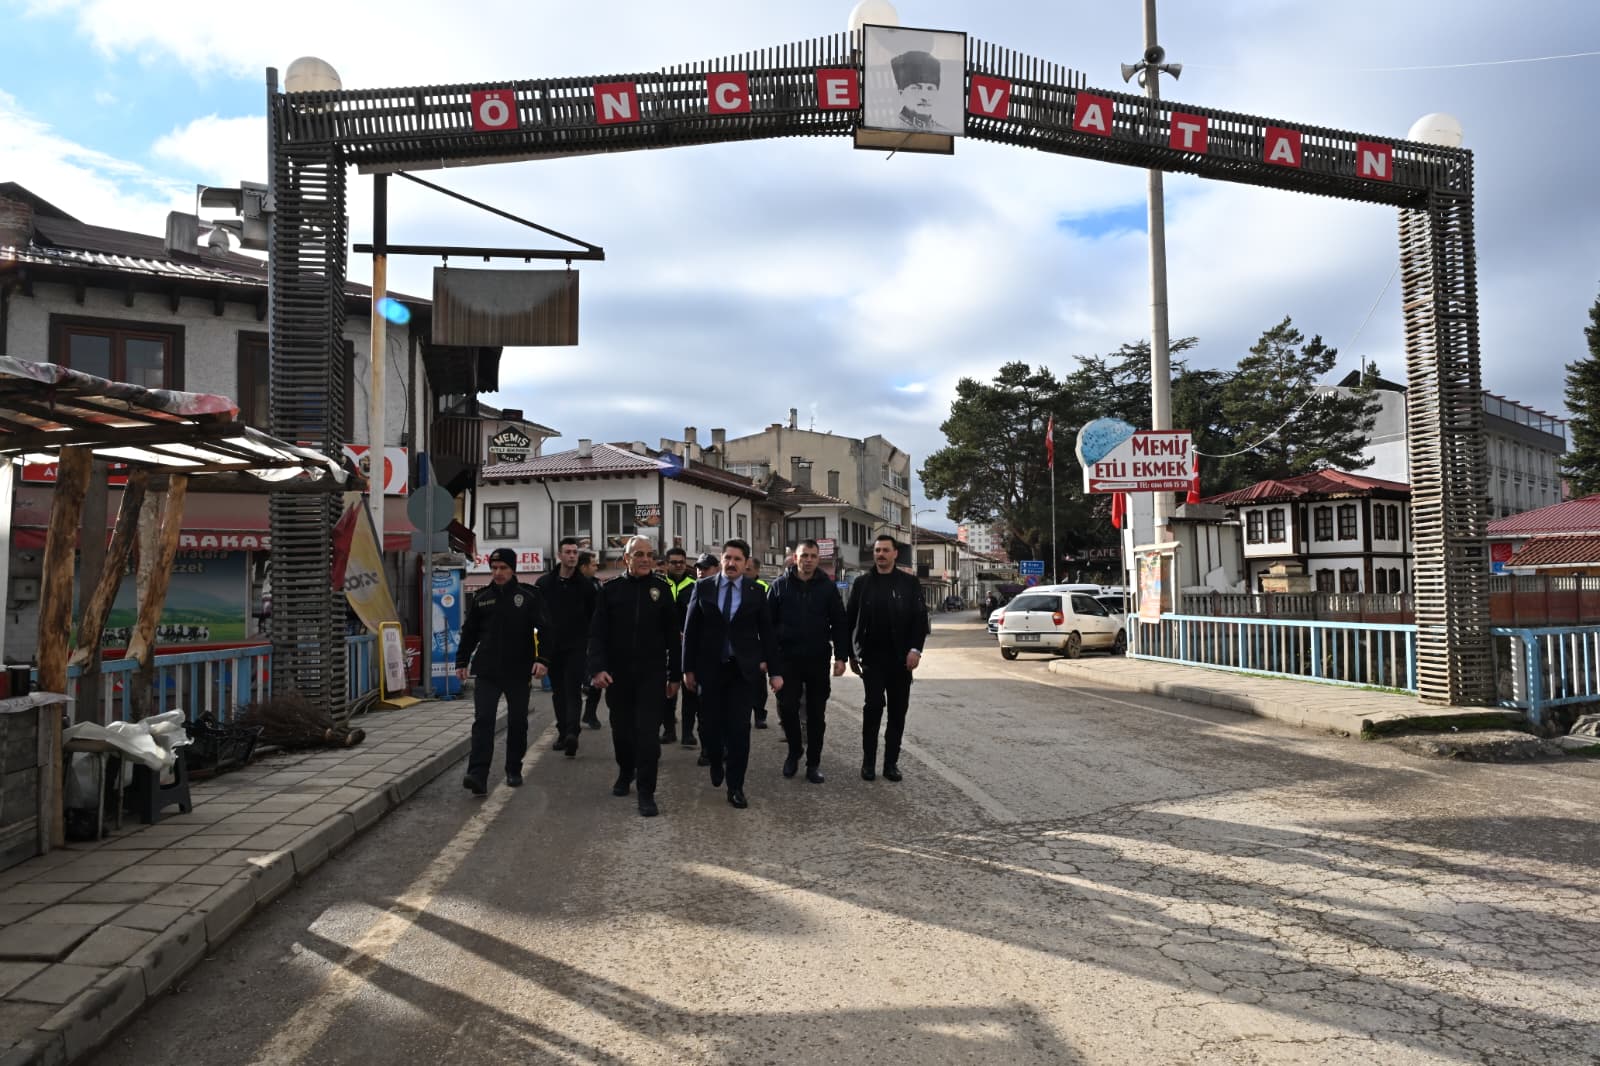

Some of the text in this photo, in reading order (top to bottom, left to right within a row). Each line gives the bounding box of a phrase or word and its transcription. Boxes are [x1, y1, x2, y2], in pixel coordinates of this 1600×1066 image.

[479, 79, 1388, 177] ÖNCE VATAN
[1132, 435, 1188, 459] MEMİŞ
[1133, 461, 1188, 477] EKMEK
